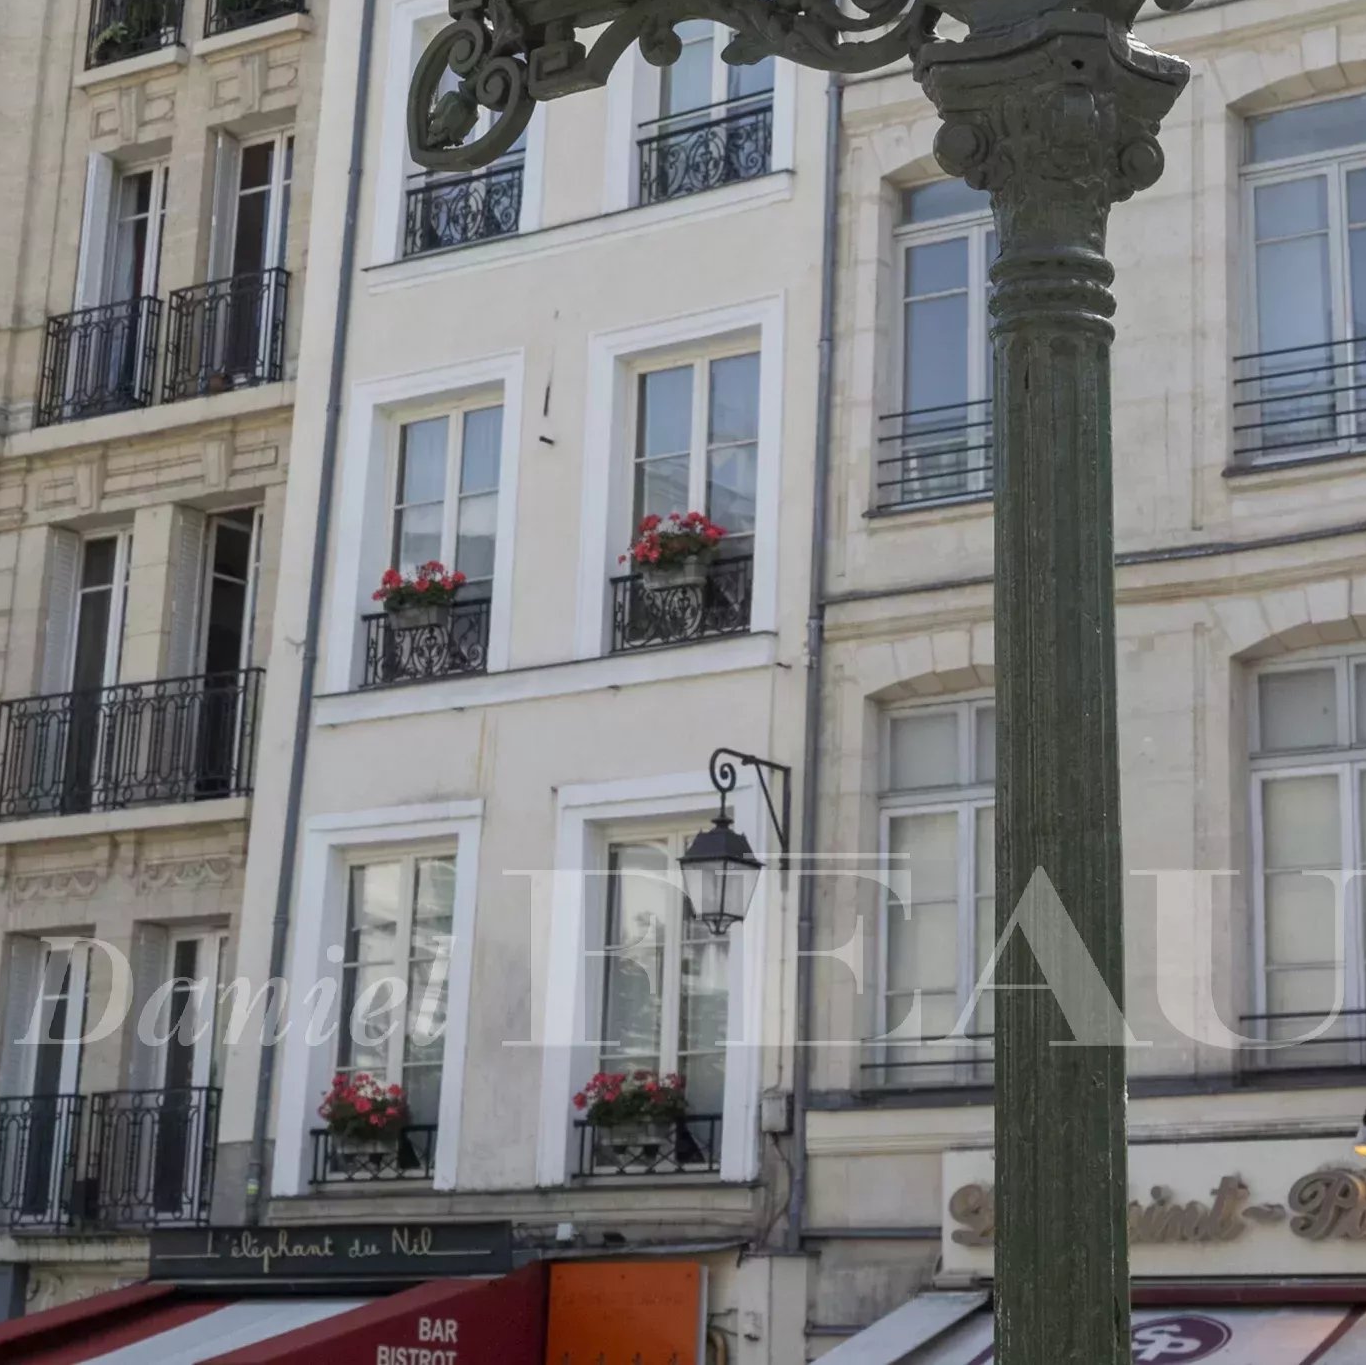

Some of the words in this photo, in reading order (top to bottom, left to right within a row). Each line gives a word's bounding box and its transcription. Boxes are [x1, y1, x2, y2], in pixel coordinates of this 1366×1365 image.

[207, 1231, 334, 1274] L'éléphant
[349, 1238, 381, 1258] du
[392, 1227, 434, 1256] Nil
[418, 1317, 458, 1343] BAR
[376, 1345, 457, 1365] BISTROT
